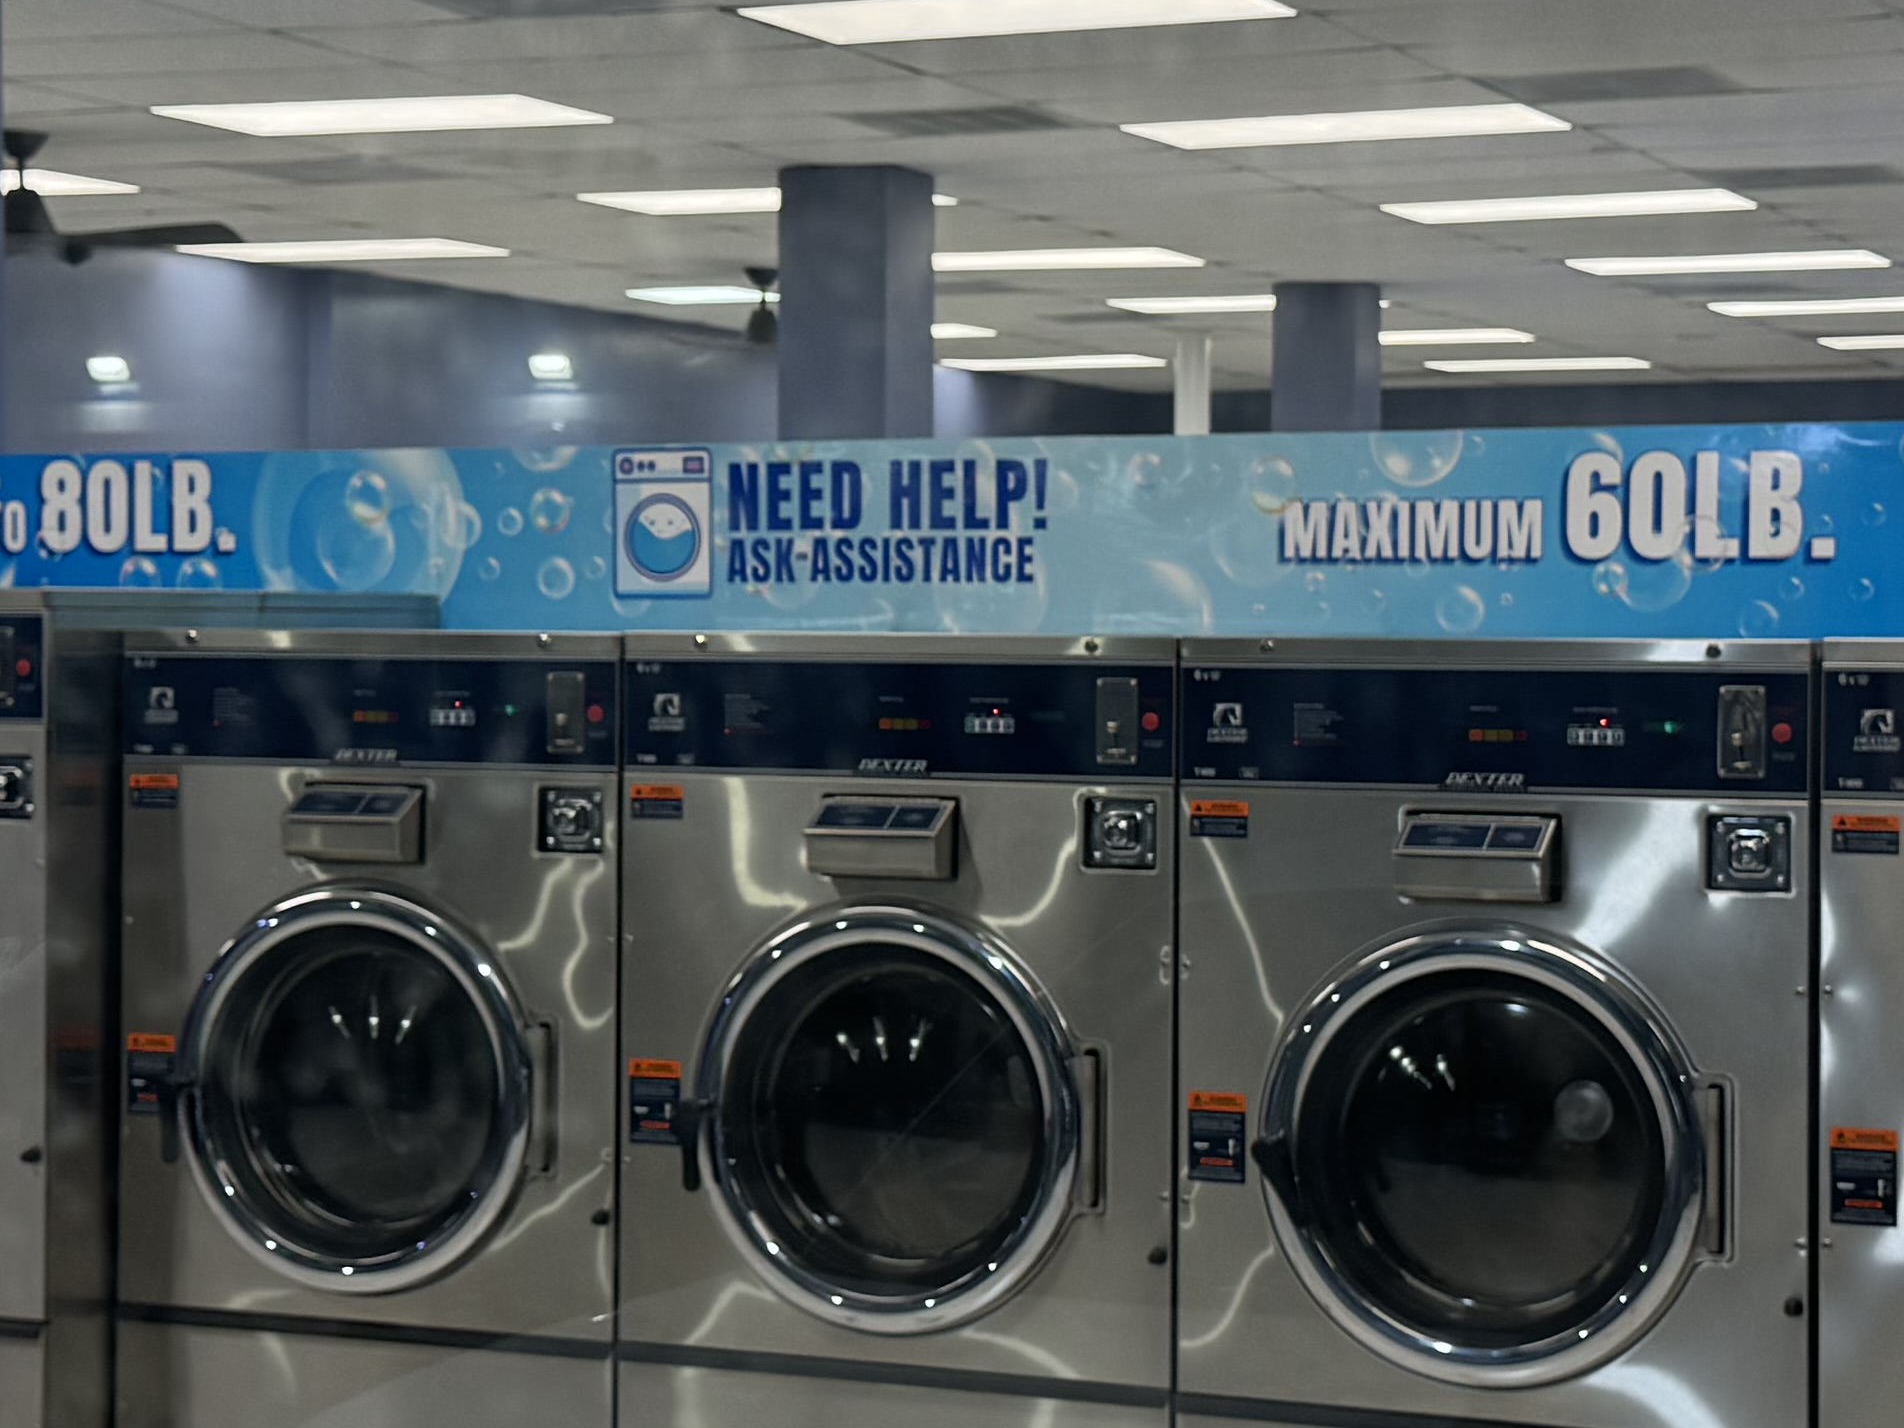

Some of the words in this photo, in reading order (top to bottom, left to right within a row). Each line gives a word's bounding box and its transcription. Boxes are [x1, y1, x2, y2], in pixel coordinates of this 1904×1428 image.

[40, 459, 236, 553] 80LB.
[727, 460, 864, 532] NEED
[888, 457, 1049, 532] HELP!
[1280, 499, 1543, 563] MAXIMUM
[1564, 450, 1836, 561] 60LB.
[857, 757, 928, 772] DEXTER
[1444, 771, 1525, 786] DEXTER
